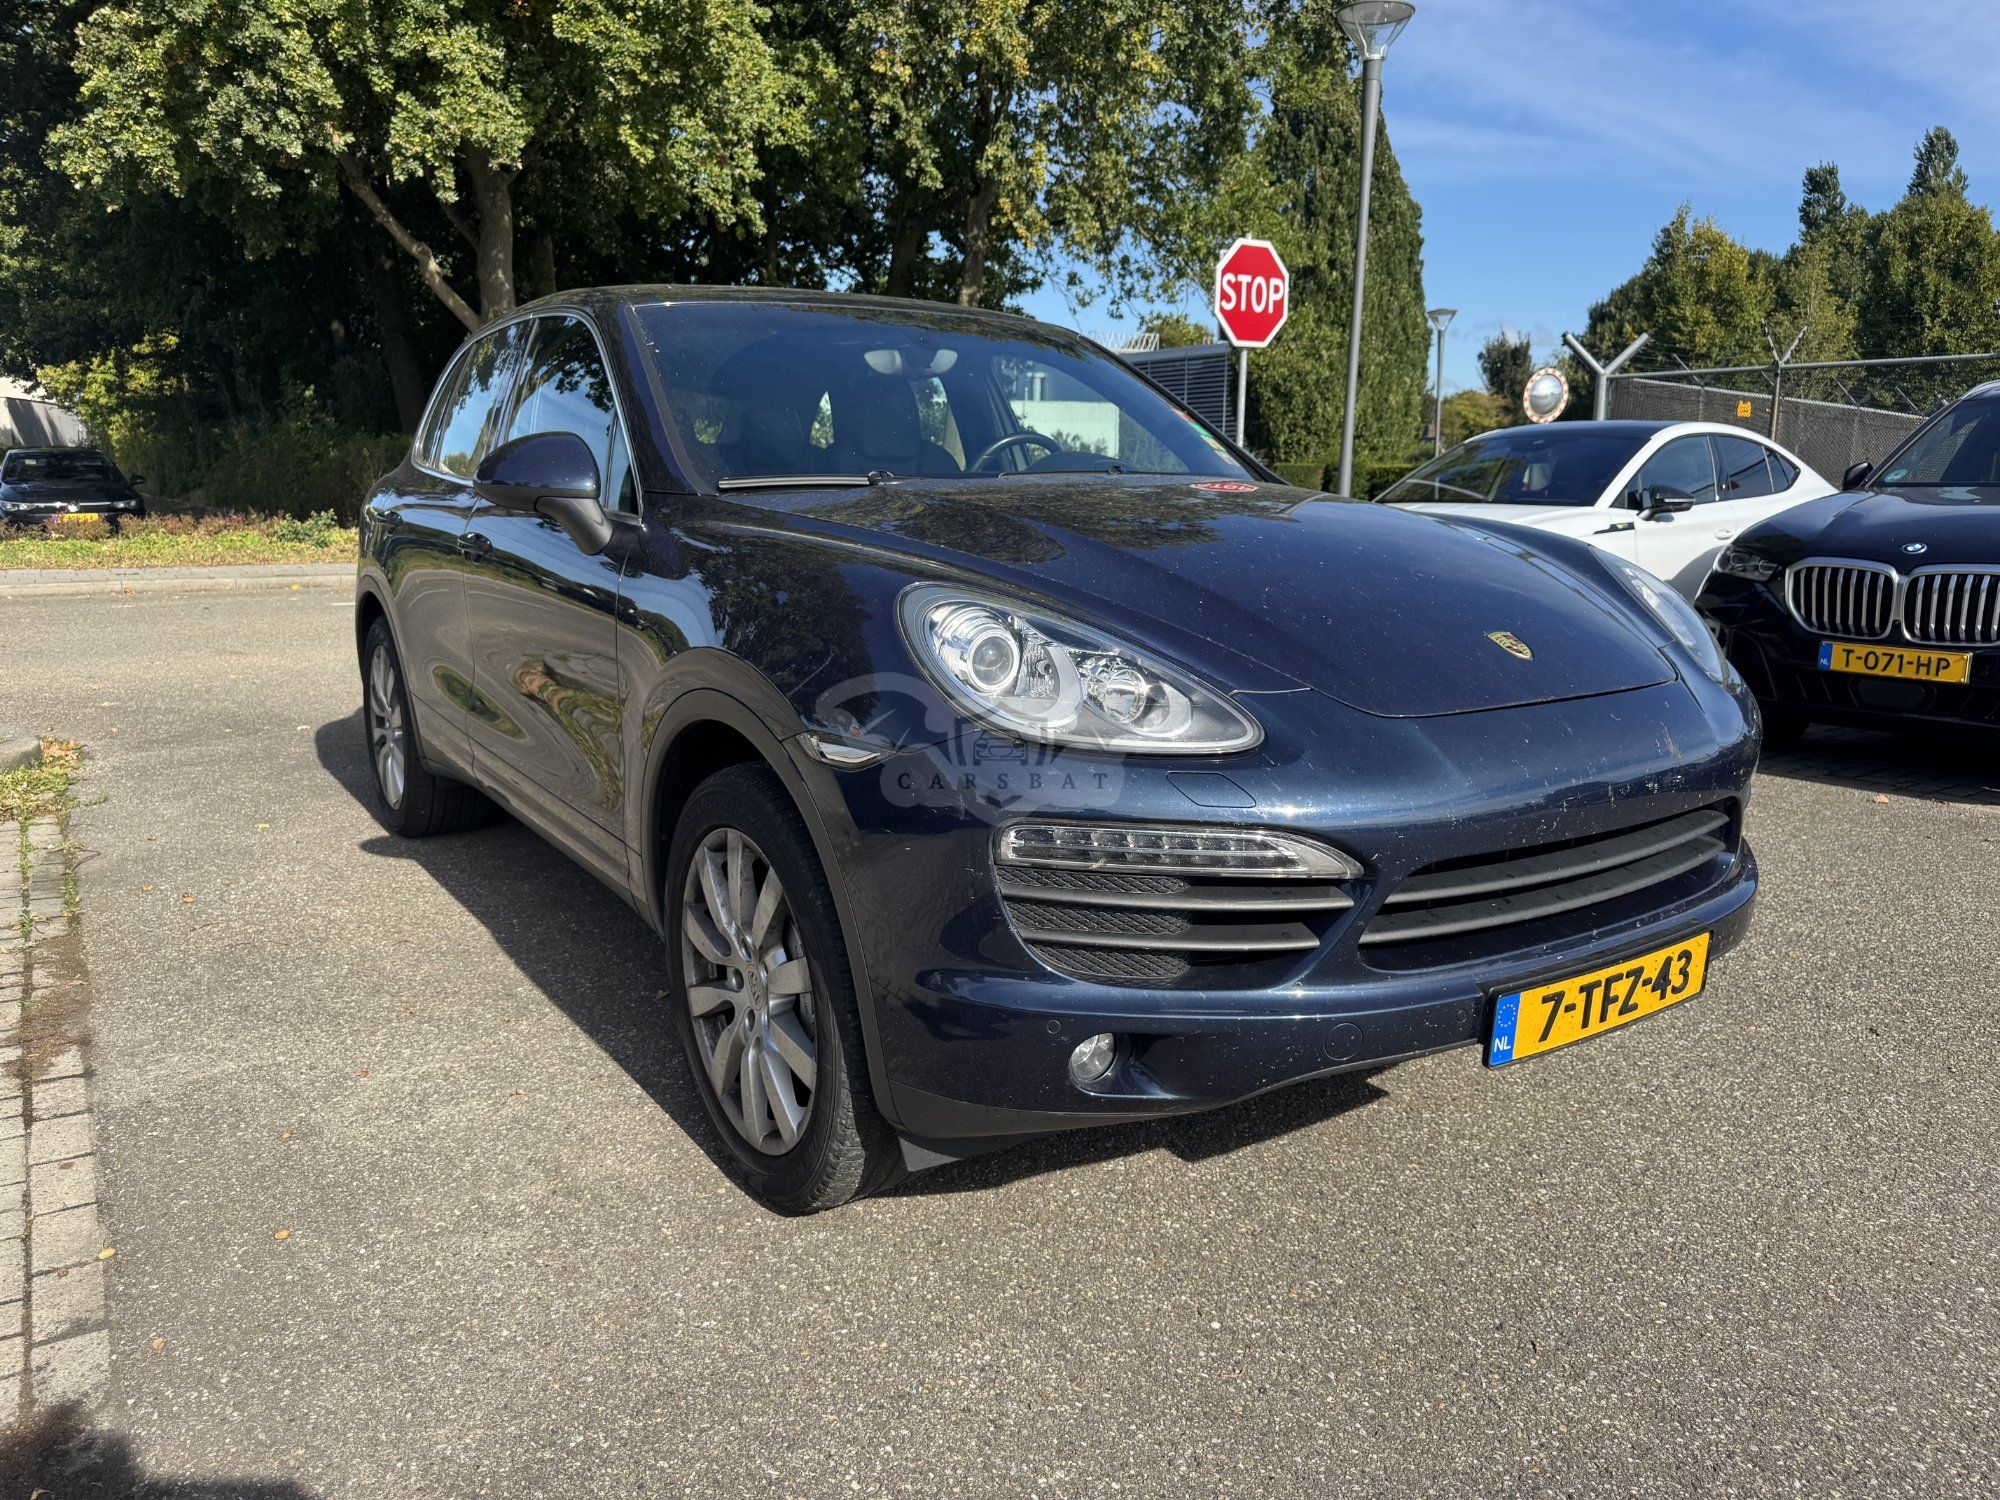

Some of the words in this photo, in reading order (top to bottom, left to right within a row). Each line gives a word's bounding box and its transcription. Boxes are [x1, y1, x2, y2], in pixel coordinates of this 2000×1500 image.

[1220, 272, 1285, 314] STOP
[1820, 657, 1830, 666] NL
[1842, 648, 1951, 677] T-071-HP
[1538, 949, 1693, 1043] 7-TFZ-43
[1493, 1035, 1511, 1053] NL
